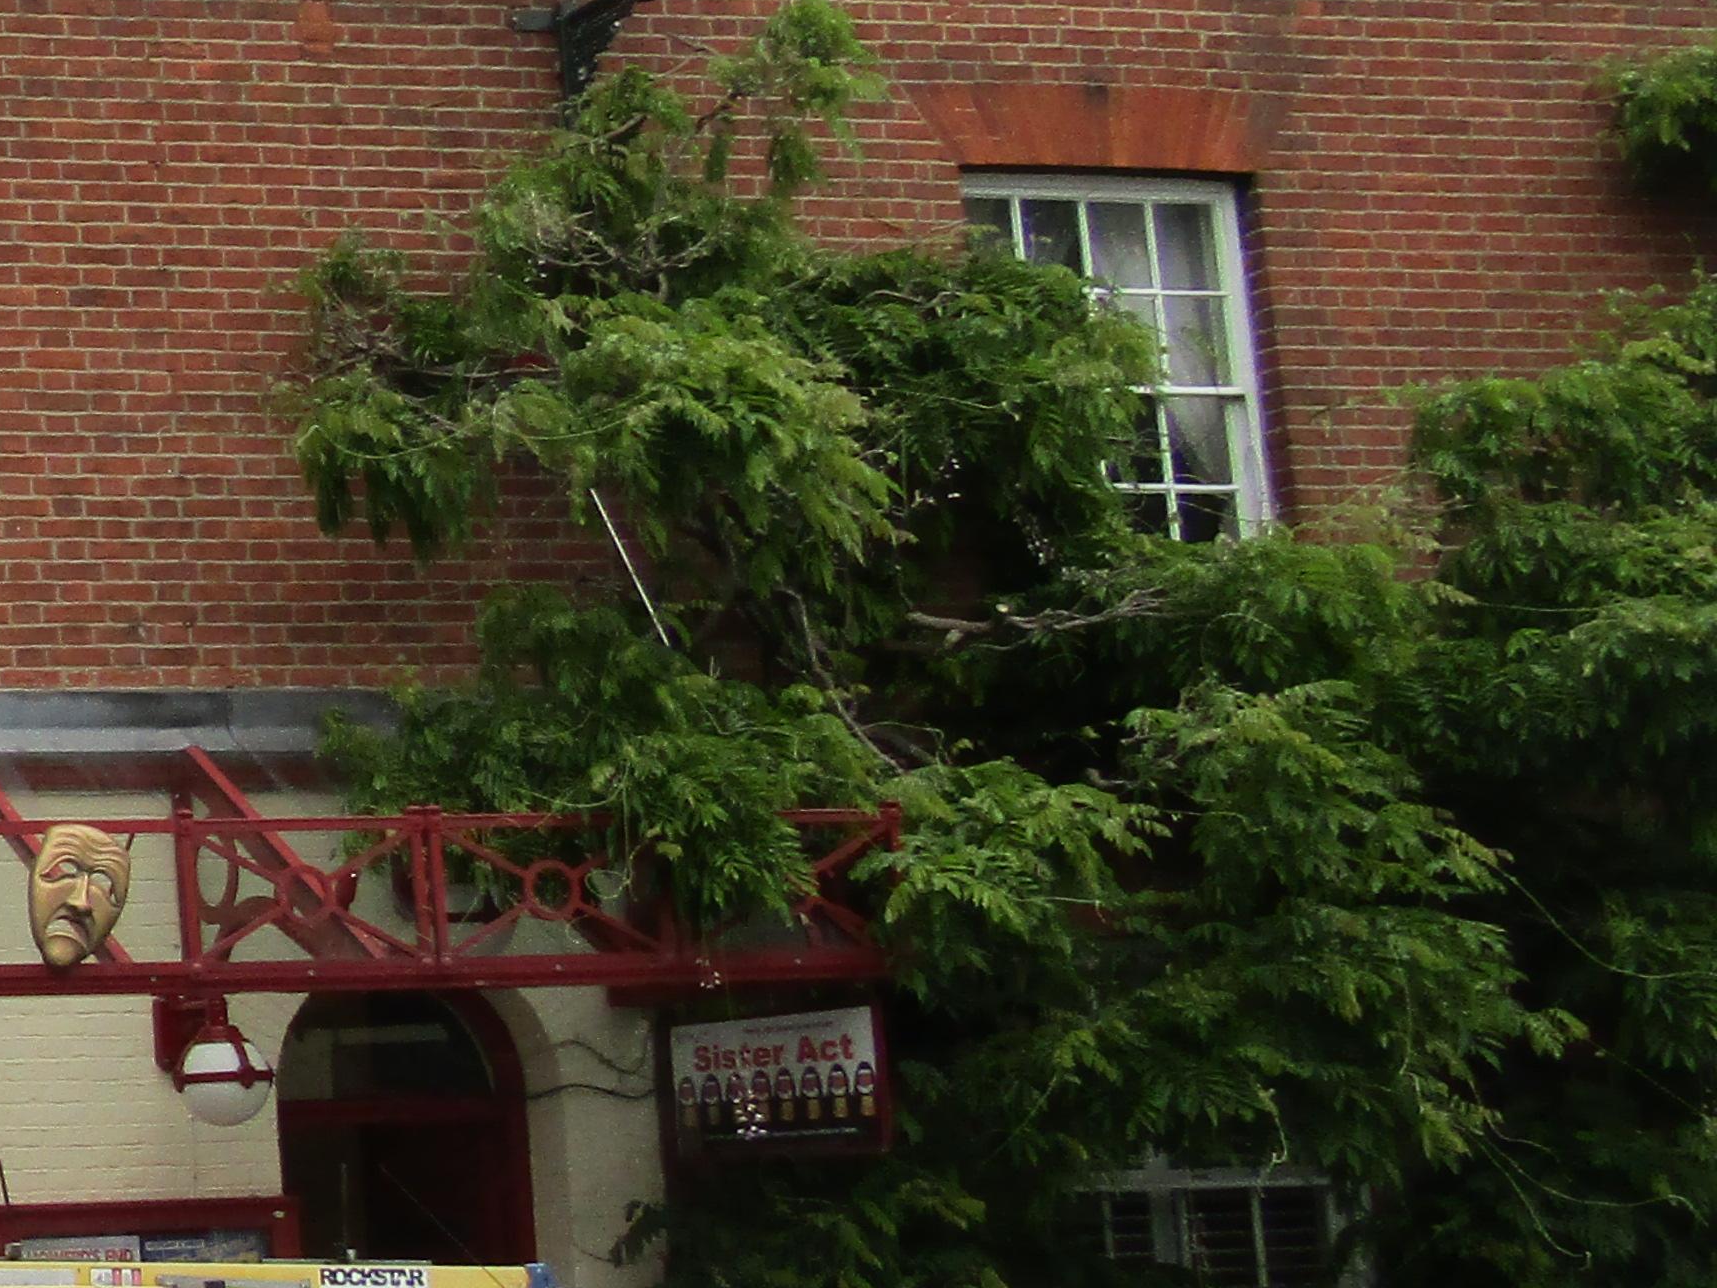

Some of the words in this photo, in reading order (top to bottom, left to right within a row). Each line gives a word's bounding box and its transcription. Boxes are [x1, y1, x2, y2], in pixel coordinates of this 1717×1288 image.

[692, 1042, 788, 1073] Sister
[797, 1033, 856, 1063] Act
[319, 1268, 425, 1286] ROCKSTAR
